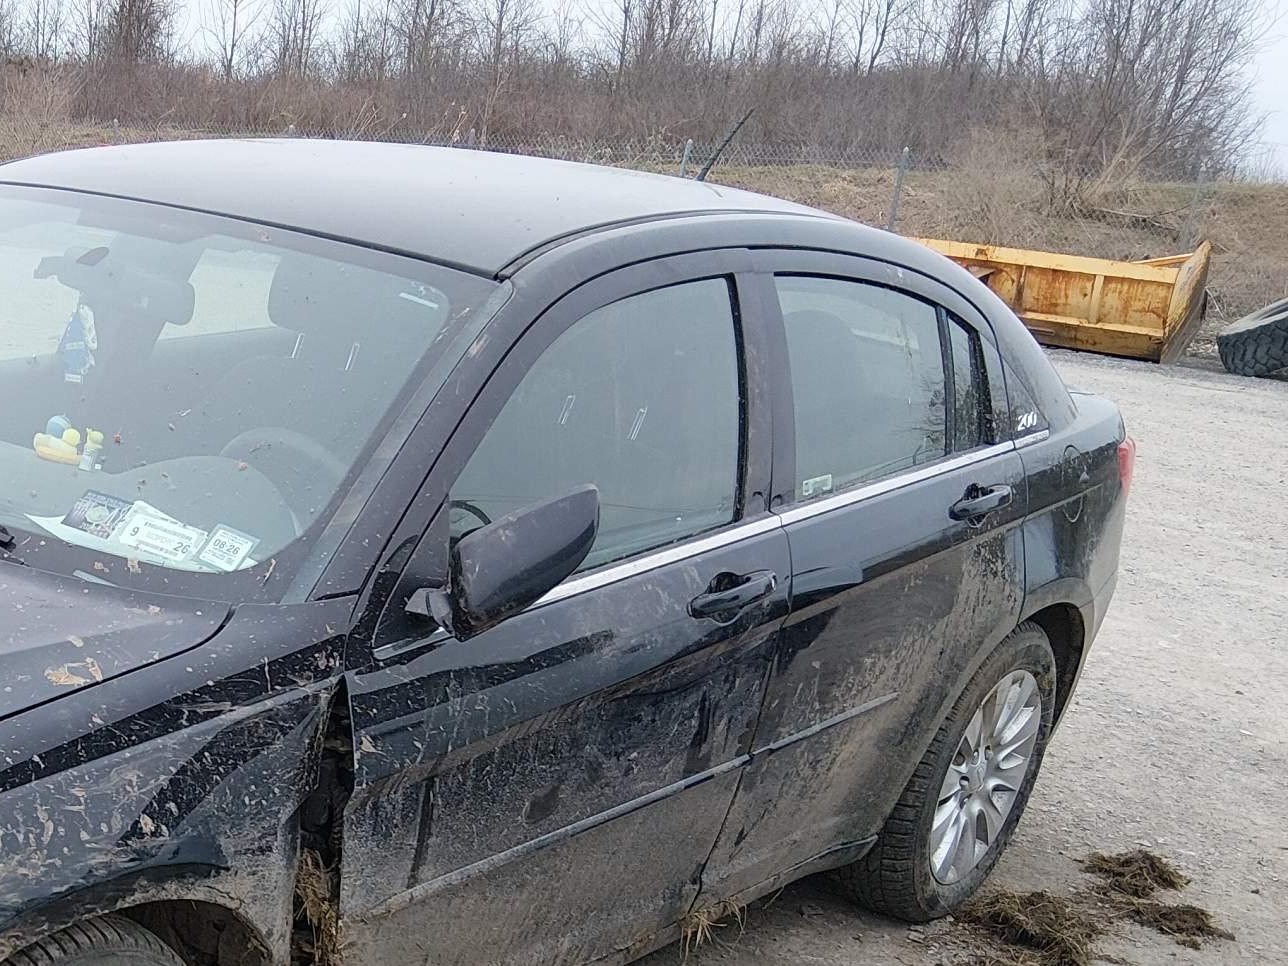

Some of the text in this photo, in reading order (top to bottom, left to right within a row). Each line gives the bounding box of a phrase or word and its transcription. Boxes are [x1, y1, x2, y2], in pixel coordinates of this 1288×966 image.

[1017, 411, 1037, 431] 200
[129, 526, 140, 537] 9
[173, 541, 191, 554] 26
